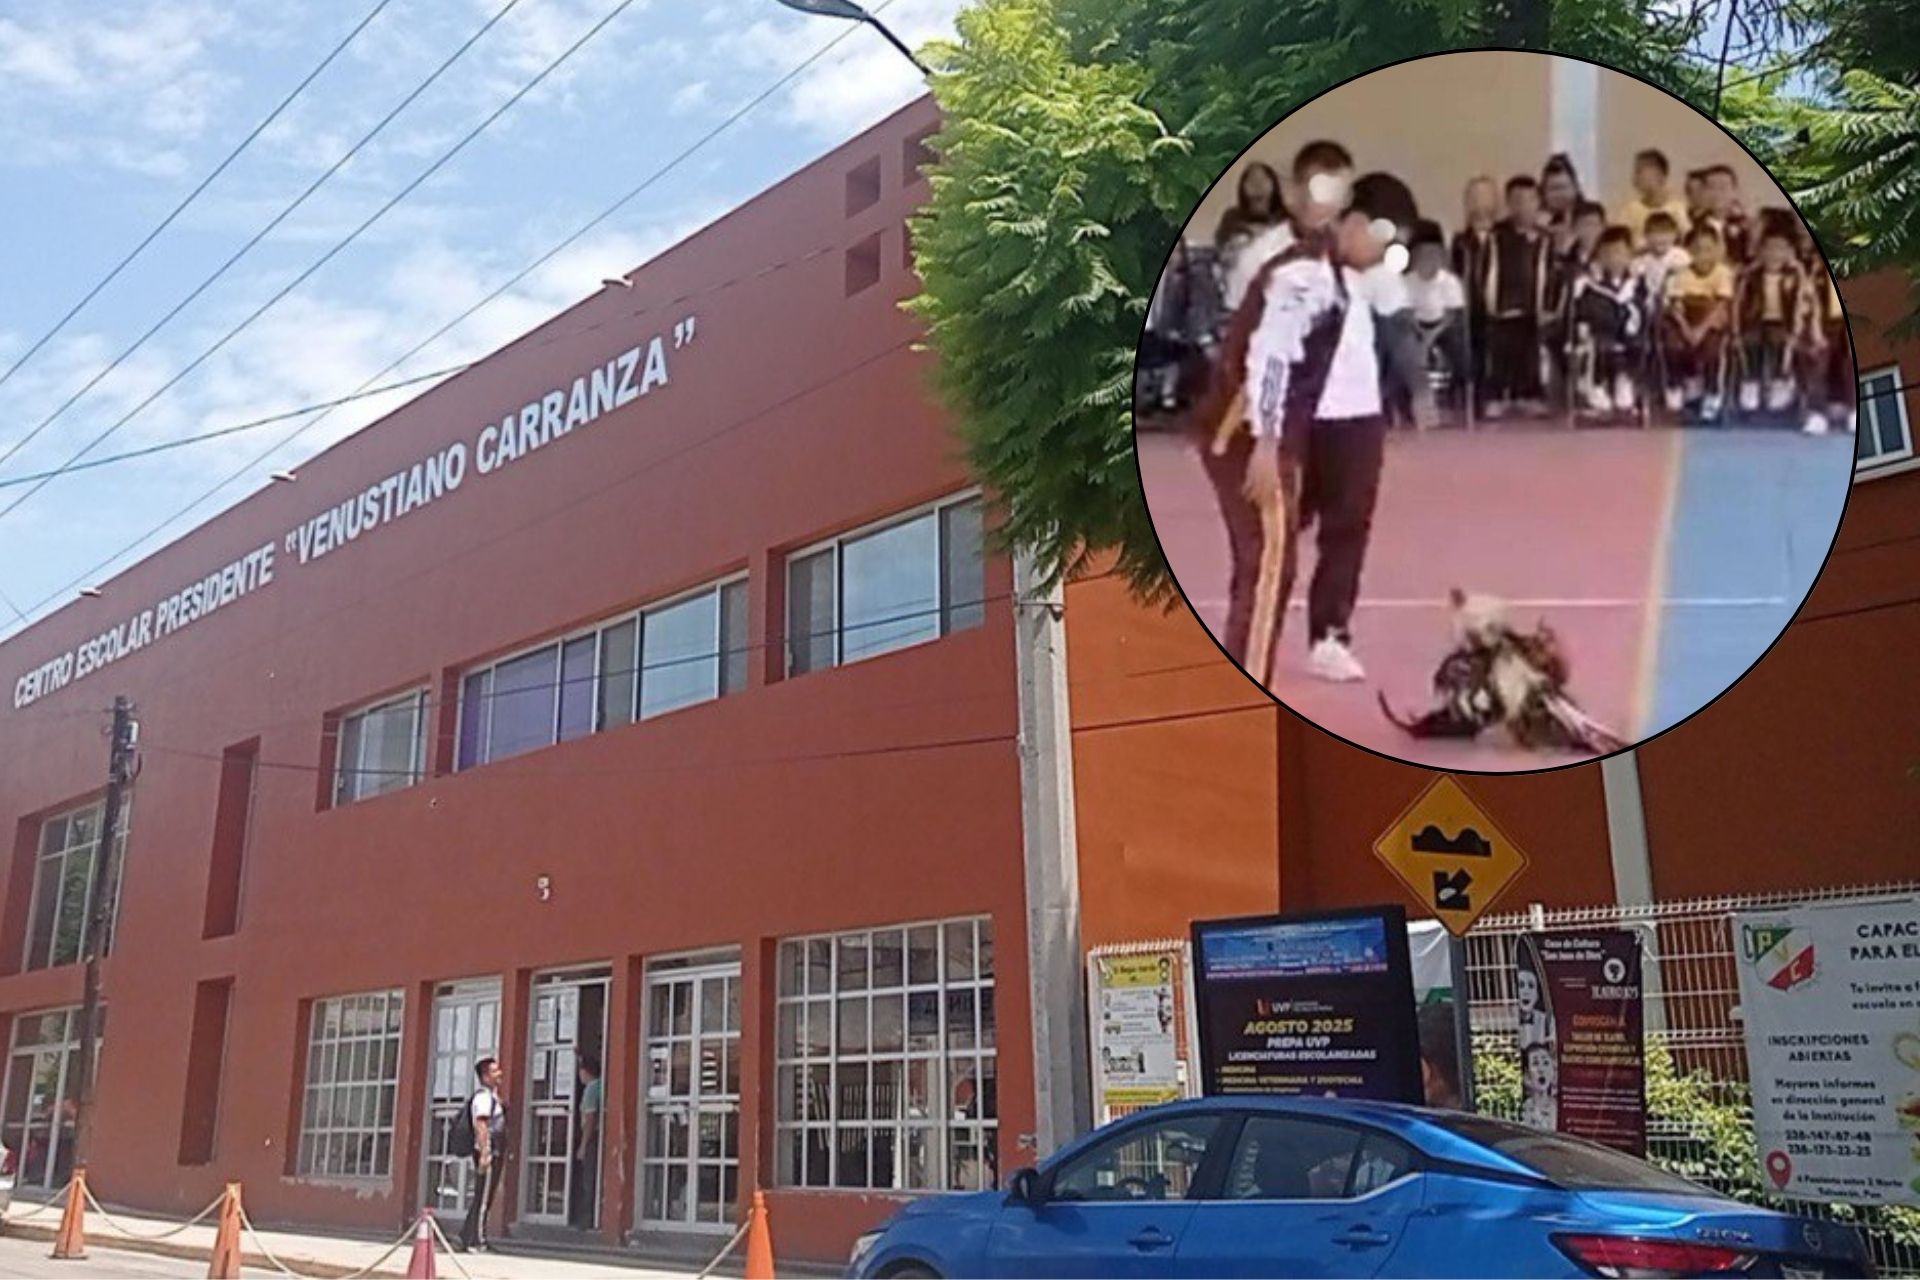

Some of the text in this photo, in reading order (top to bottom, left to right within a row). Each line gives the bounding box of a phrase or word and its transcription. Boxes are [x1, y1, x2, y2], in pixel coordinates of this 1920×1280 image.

[14, 651, 74, 709] CENTRO
[75, 610, 153, 679] ESCOLAR
[154, 542, 275, 640] PRESIDENTE
[1850, 945, 1897, 960] PARA
[1852, 998, 1896, 1010] escuela
[1244, 1019, 1354, 1035] AGOSTO 2025
[1267, 1036, 1331, 1048] PREPA UVP
[1768, 1034, 1870, 1046] INSCRIPCIONES
[1228, 1050, 1377, 1061] LICENCIATURAS ESCOLARIZADAS
[1789, 1051, 1852, 1062] ABIERTAS
[1775, 1078, 1876, 1090] Mayores informes
[1786, 1094, 1837, 1105] dirección
[1840, 1095, 1886, 1106] general
[1783, 1110, 1795, 1120] de
[1799, 1110, 1808, 1120] la
